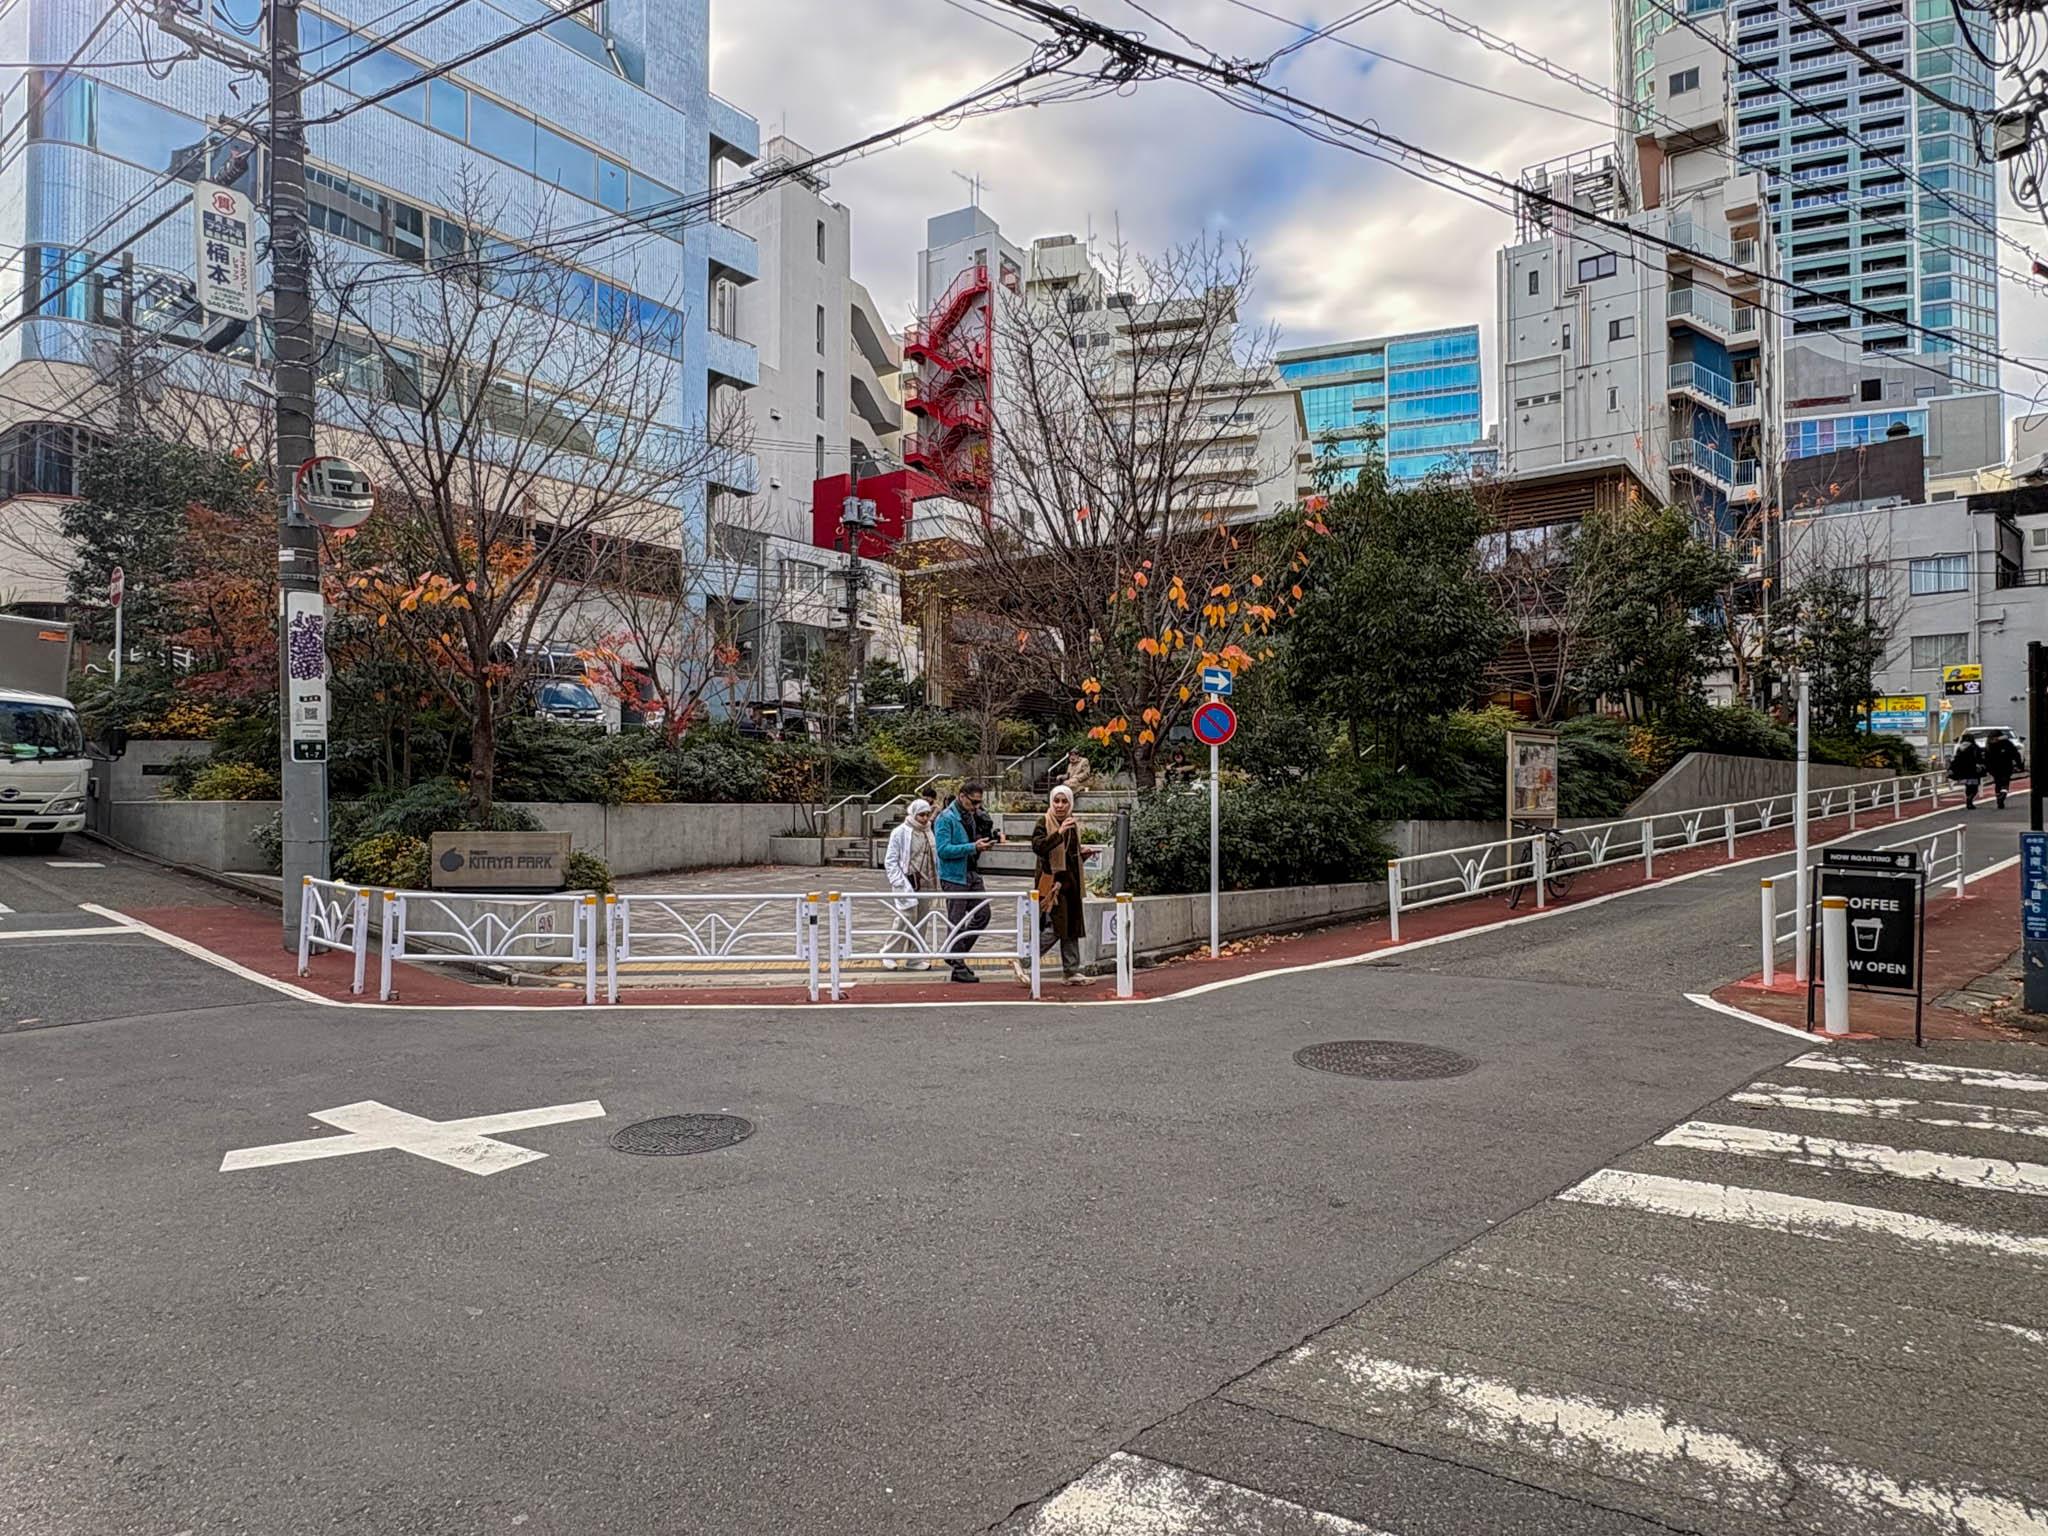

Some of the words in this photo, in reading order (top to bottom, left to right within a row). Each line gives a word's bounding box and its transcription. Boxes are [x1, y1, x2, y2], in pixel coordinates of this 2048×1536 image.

[206, 240, 231, 285] 楠本
[1700, 755, 1757, 797] KITAYA
[1763, 763, 1793, 795] PAR
[469, 856, 514, 869] KITAYA
[517, 857, 552, 869] PARK
[1851, 855, 1891, 863] ROASTING
[1848, 898, 1900, 911] OFFEE
[1866, 962, 1906, 974] OPEN
